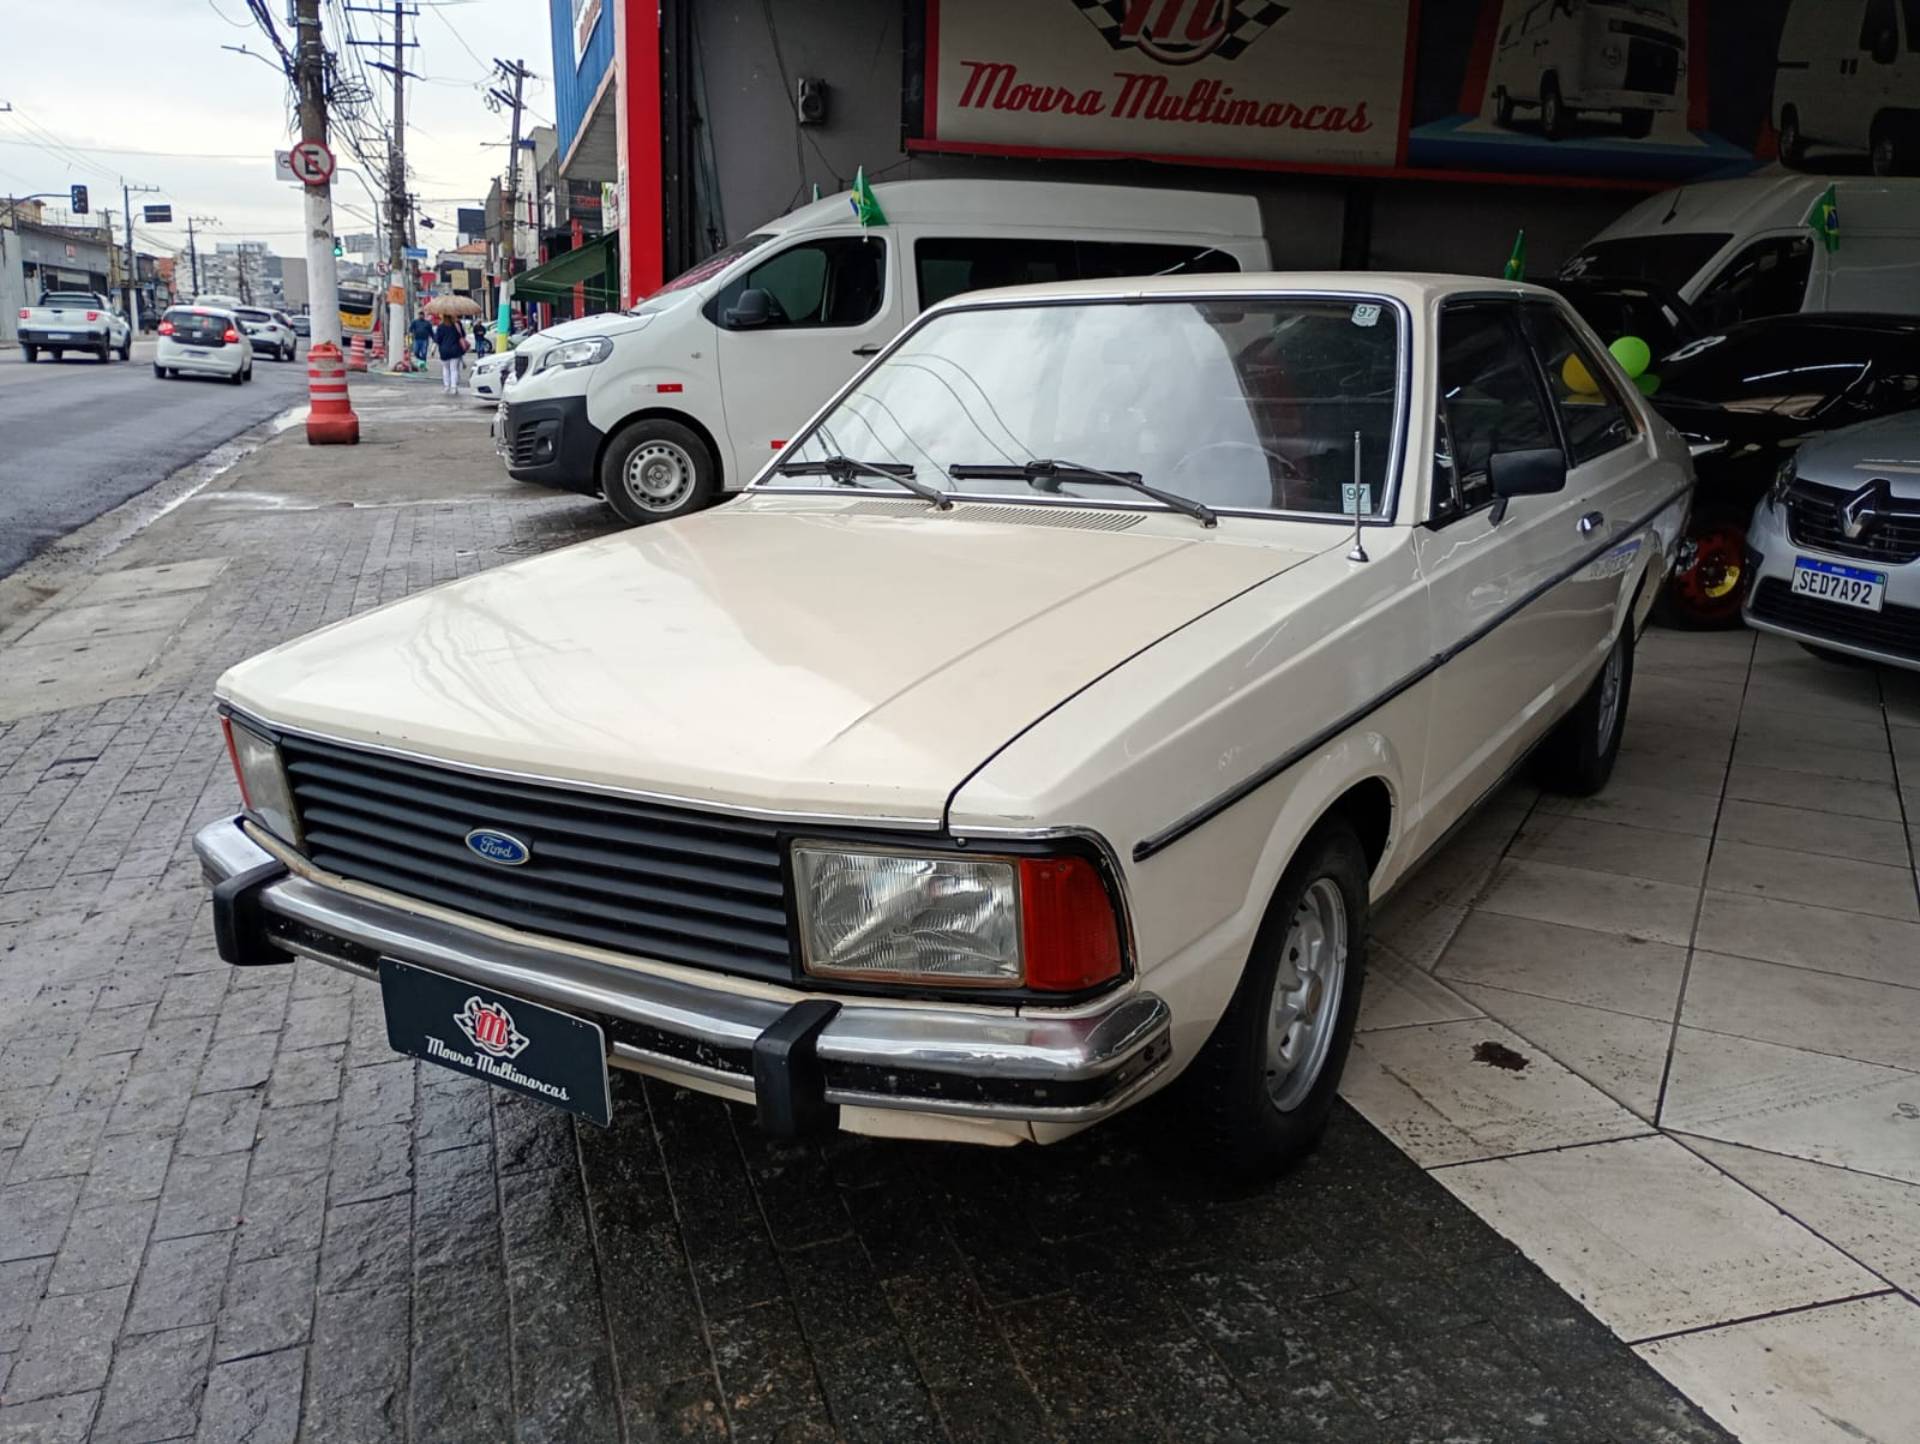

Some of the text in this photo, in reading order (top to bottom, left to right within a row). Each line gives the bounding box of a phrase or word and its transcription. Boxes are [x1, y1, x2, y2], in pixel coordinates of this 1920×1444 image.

[958, 60, 1373, 133] Moura Multimarcas
[304, 150, 320, 174] E
[1357, 306, 1377, 318] 97
[1346, 487, 1366, 500] 97
[1799, 570, 1873, 605] SED7A92
[480, 836, 513, 858] Ford
[425, 1035, 570, 1100] Moura Multimarcas
